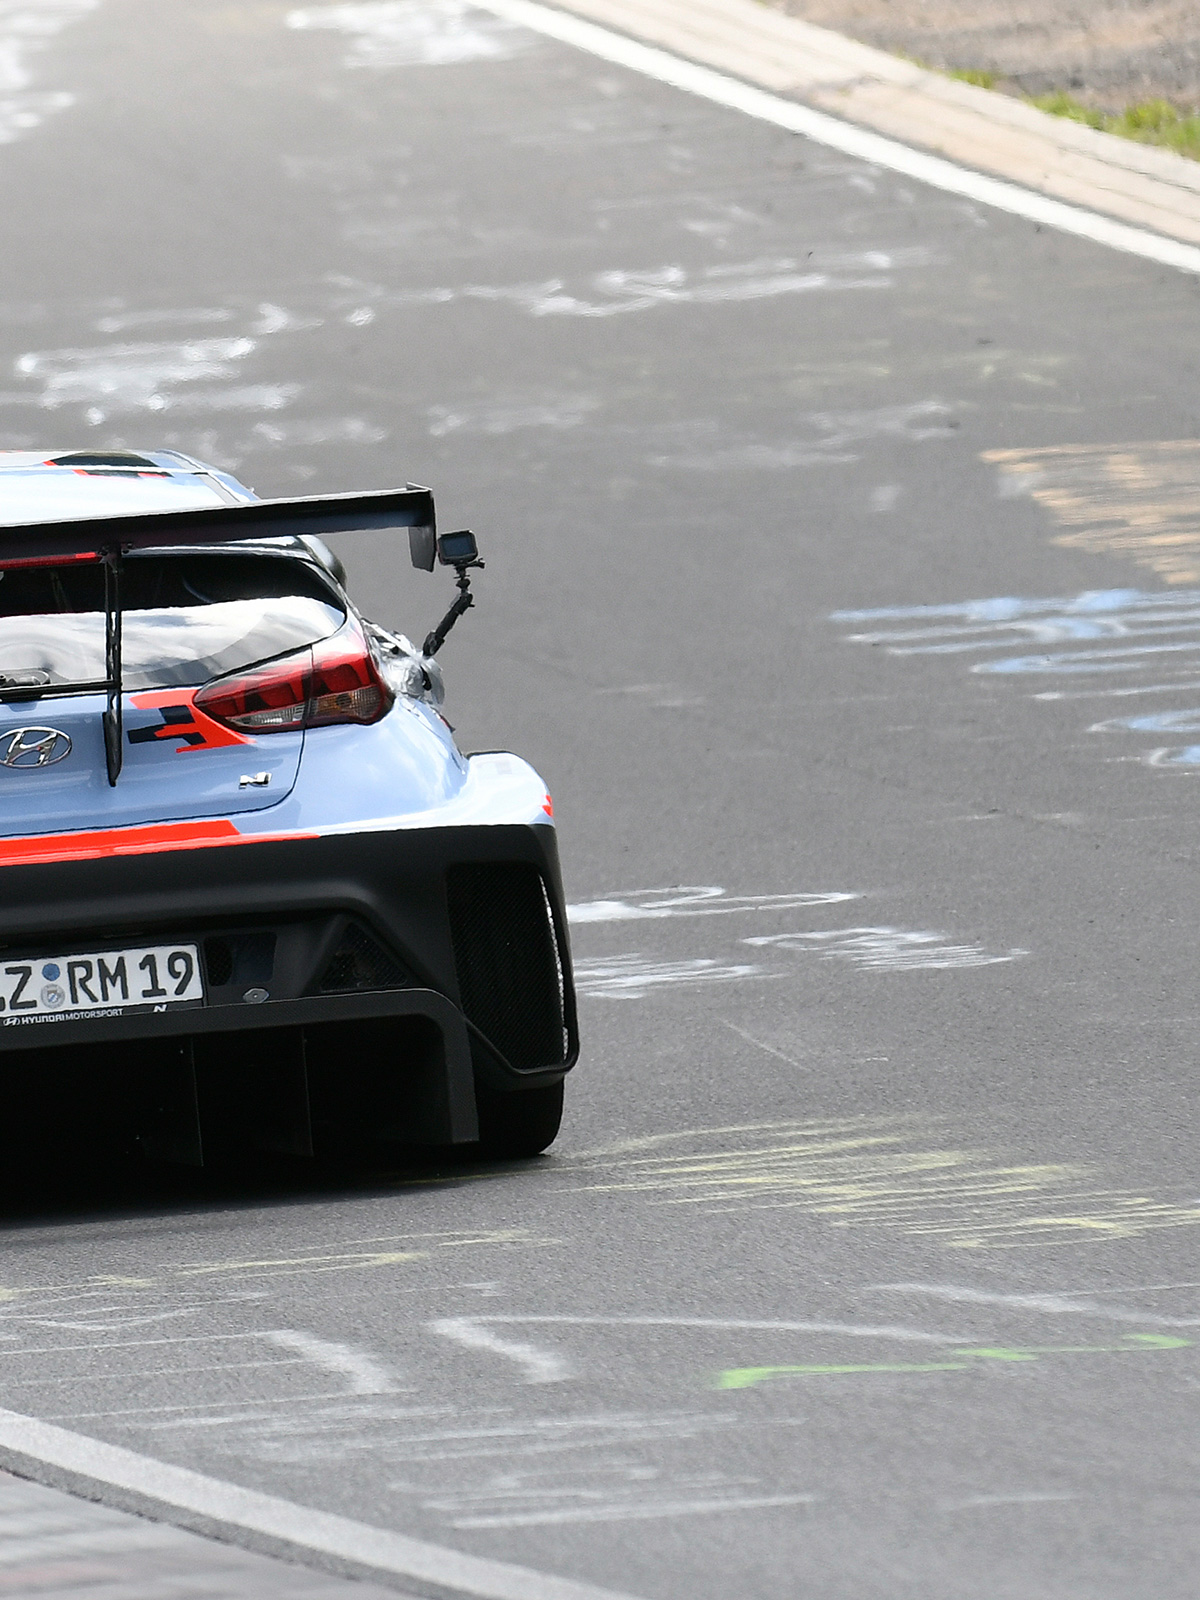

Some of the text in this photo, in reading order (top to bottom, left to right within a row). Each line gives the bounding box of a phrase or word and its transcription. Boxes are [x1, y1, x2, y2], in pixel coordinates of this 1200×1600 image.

[67, 955, 130, 1005] RM
[138, 951, 194, 999] 19
[21, 1008, 123, 1025] HYUNDAI MOTORSPORT
